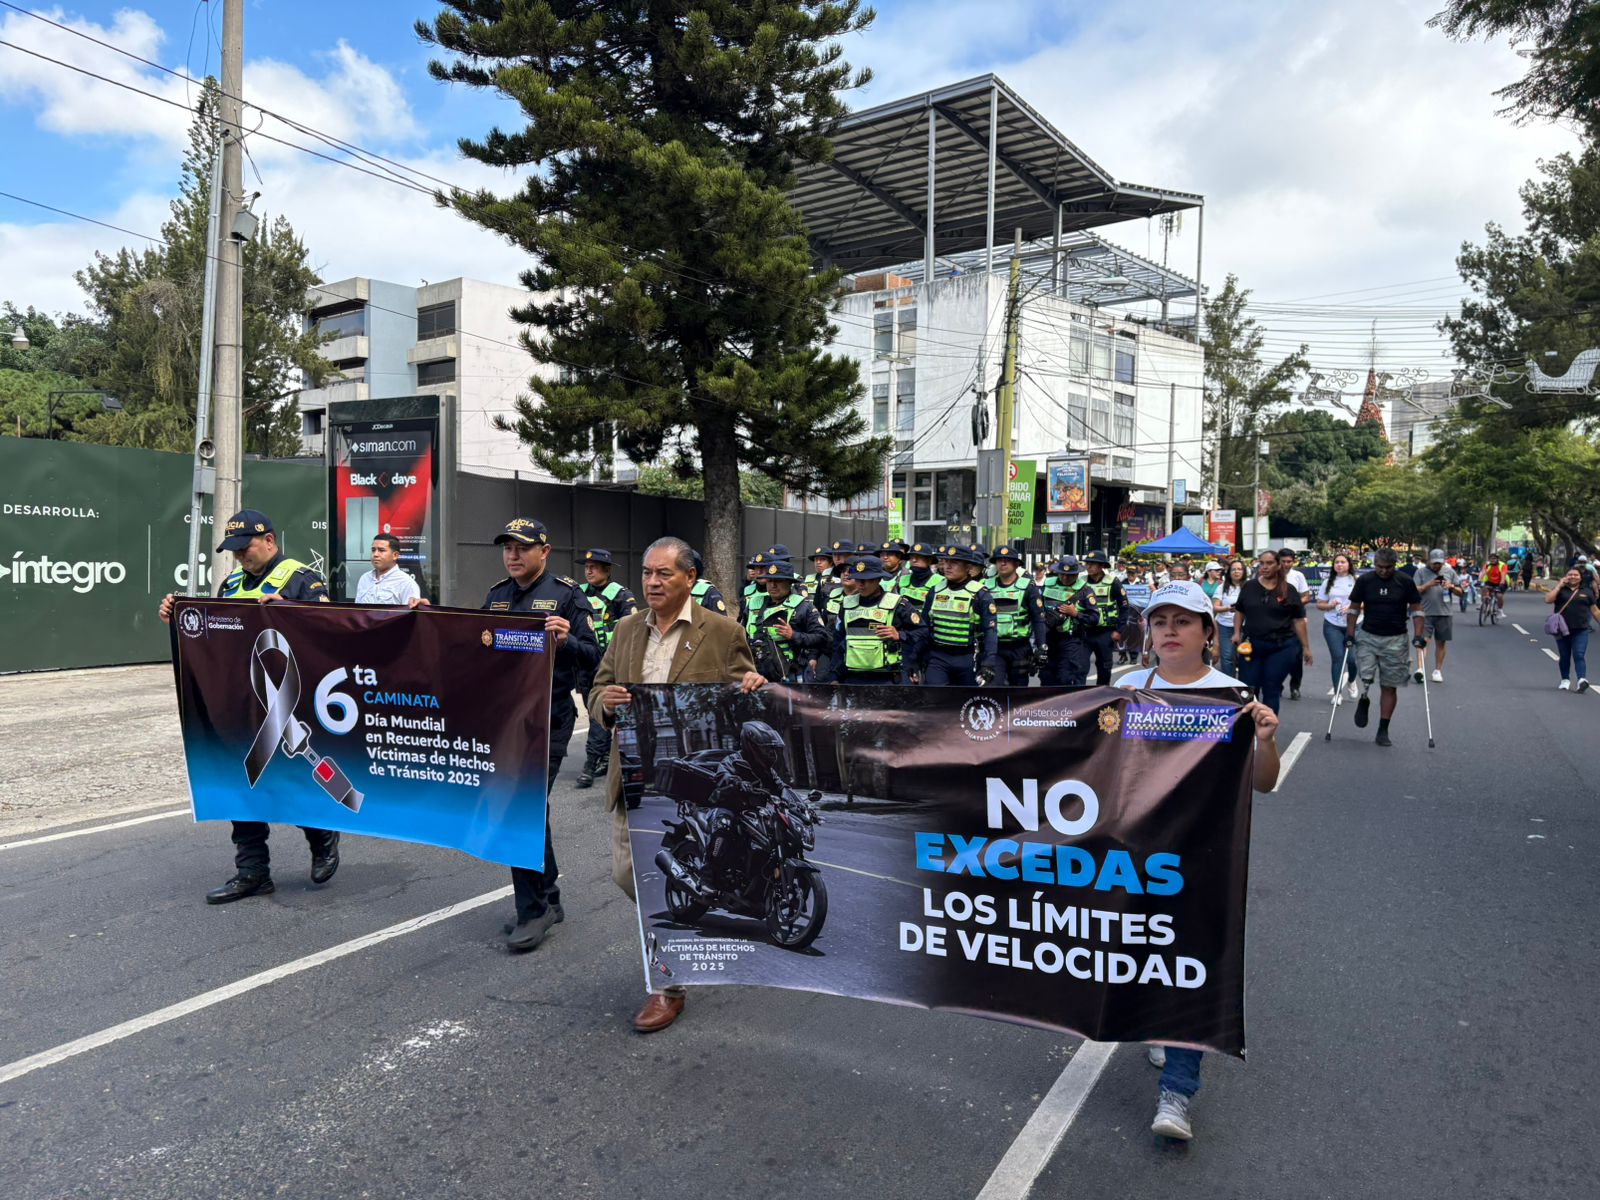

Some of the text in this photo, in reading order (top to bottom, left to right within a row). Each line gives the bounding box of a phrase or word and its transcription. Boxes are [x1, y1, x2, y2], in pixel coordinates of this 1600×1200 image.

[359, 439, 417, 453] siman.com
[350, 472, 417, 488] Black days
[3, 503, 100, 519] DESARROLLA:
[12, 550, 126, 594] íntegro
[208, 622, 244, 631] Gobernación
[495, 632, 544, 644] TRÁNSITO PNC
[363, 691, 440, 709] CAMINATA
[1013, 706, 1073, 718] Ministerio de
[1126, 709, 1230, 726] TRÁNSITO PNC
[1154, 706, 1216, 714] DEPARTAMENTO
[364, 713, 446, 732] Día Mundial
[1012, 717, 1077, 728] Gobernación
[365, 731, 491, 754] en Recuerdo de las
[964, 729, 1000, 742] GUATEMALA
[366, 746, 496, 773] Víctimas de Hechos
[368, 762, 480, 787] de Tránsito 2025
[985, 777, 1100, 836] NO
[914, 831, 1185, 896] EXCEDAS
[923, 887, 1176, 946] LOS LÍMITES
[660, 943, 756, 953] VÍCTIMAS DE HECHOS
[679, 951, 738, 961] DE TRÁNSITO
[899, 921, 1208, 989] DE VELOCIDAD
[692, 962, 725, 971] 2025
